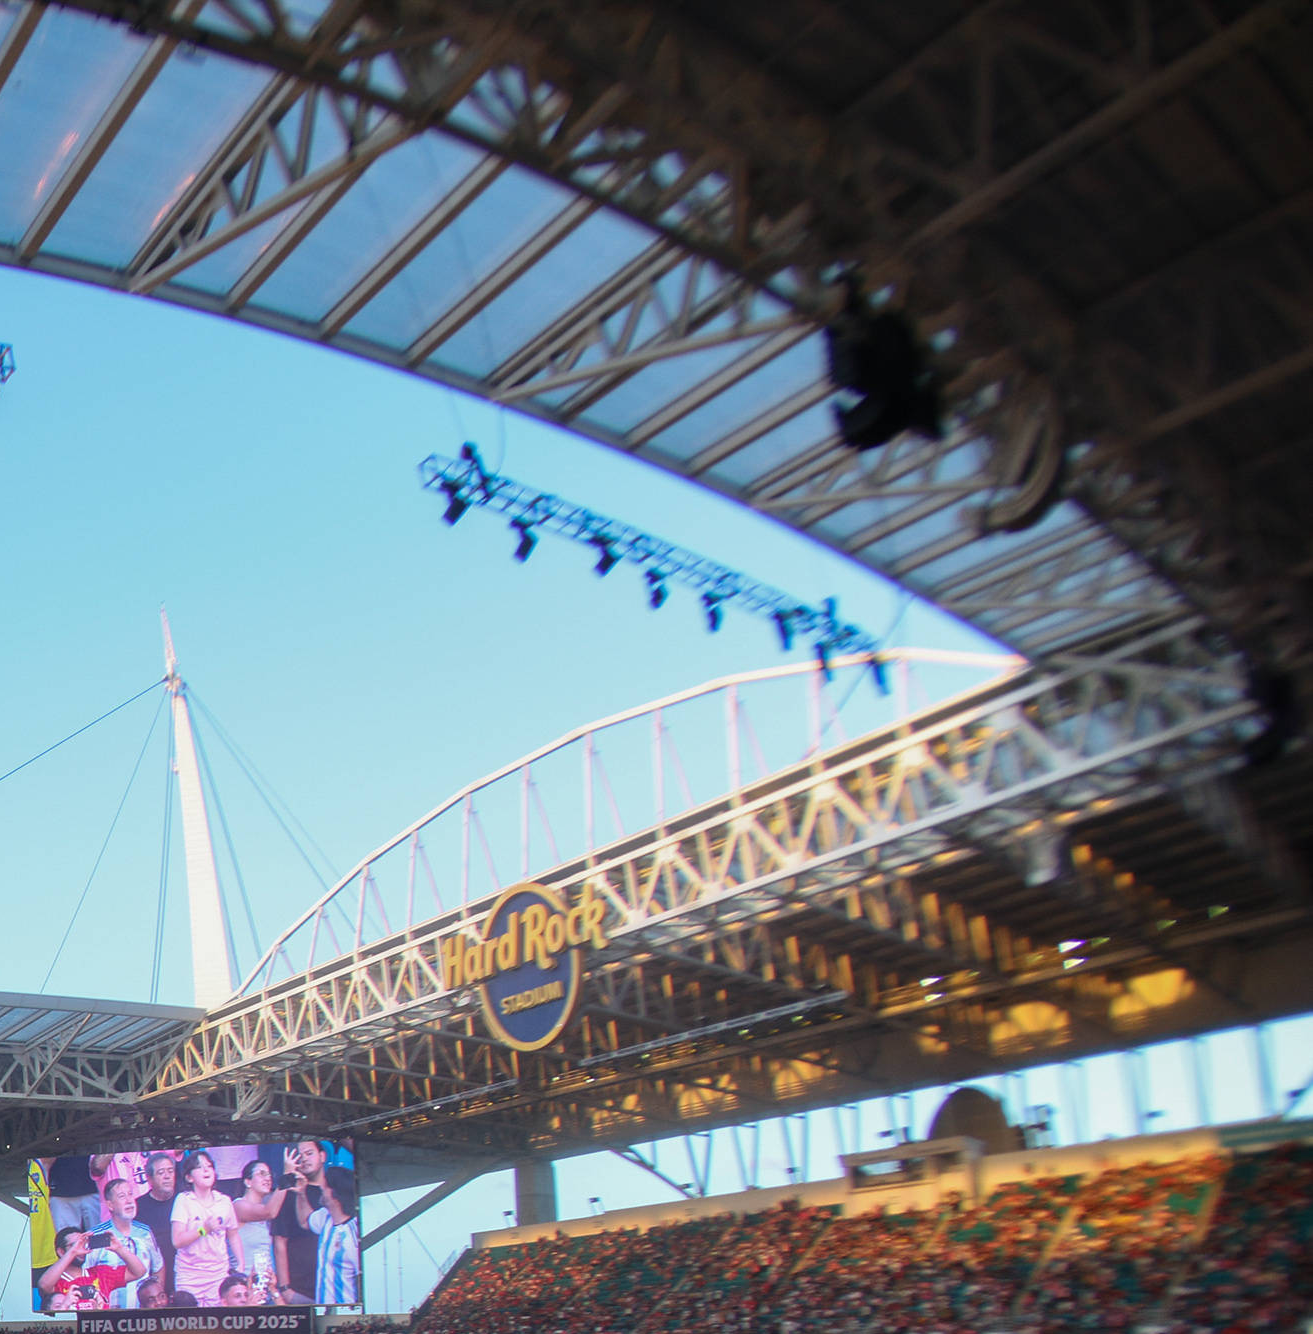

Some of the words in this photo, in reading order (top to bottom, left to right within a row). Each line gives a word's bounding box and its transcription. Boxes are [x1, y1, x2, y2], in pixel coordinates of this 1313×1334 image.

[442, 911, 519, 990] Hard
[520, 883, 610, 970] Rock
[501, 980, 565, 1015] STADIUM
[81, 1316, 115, 1334] FIFA
[117, 1315, 157, 1333] CLUB
[160, 1314, 218, 1331] WORLD
[222, 1313, 255, 1331] CUP
